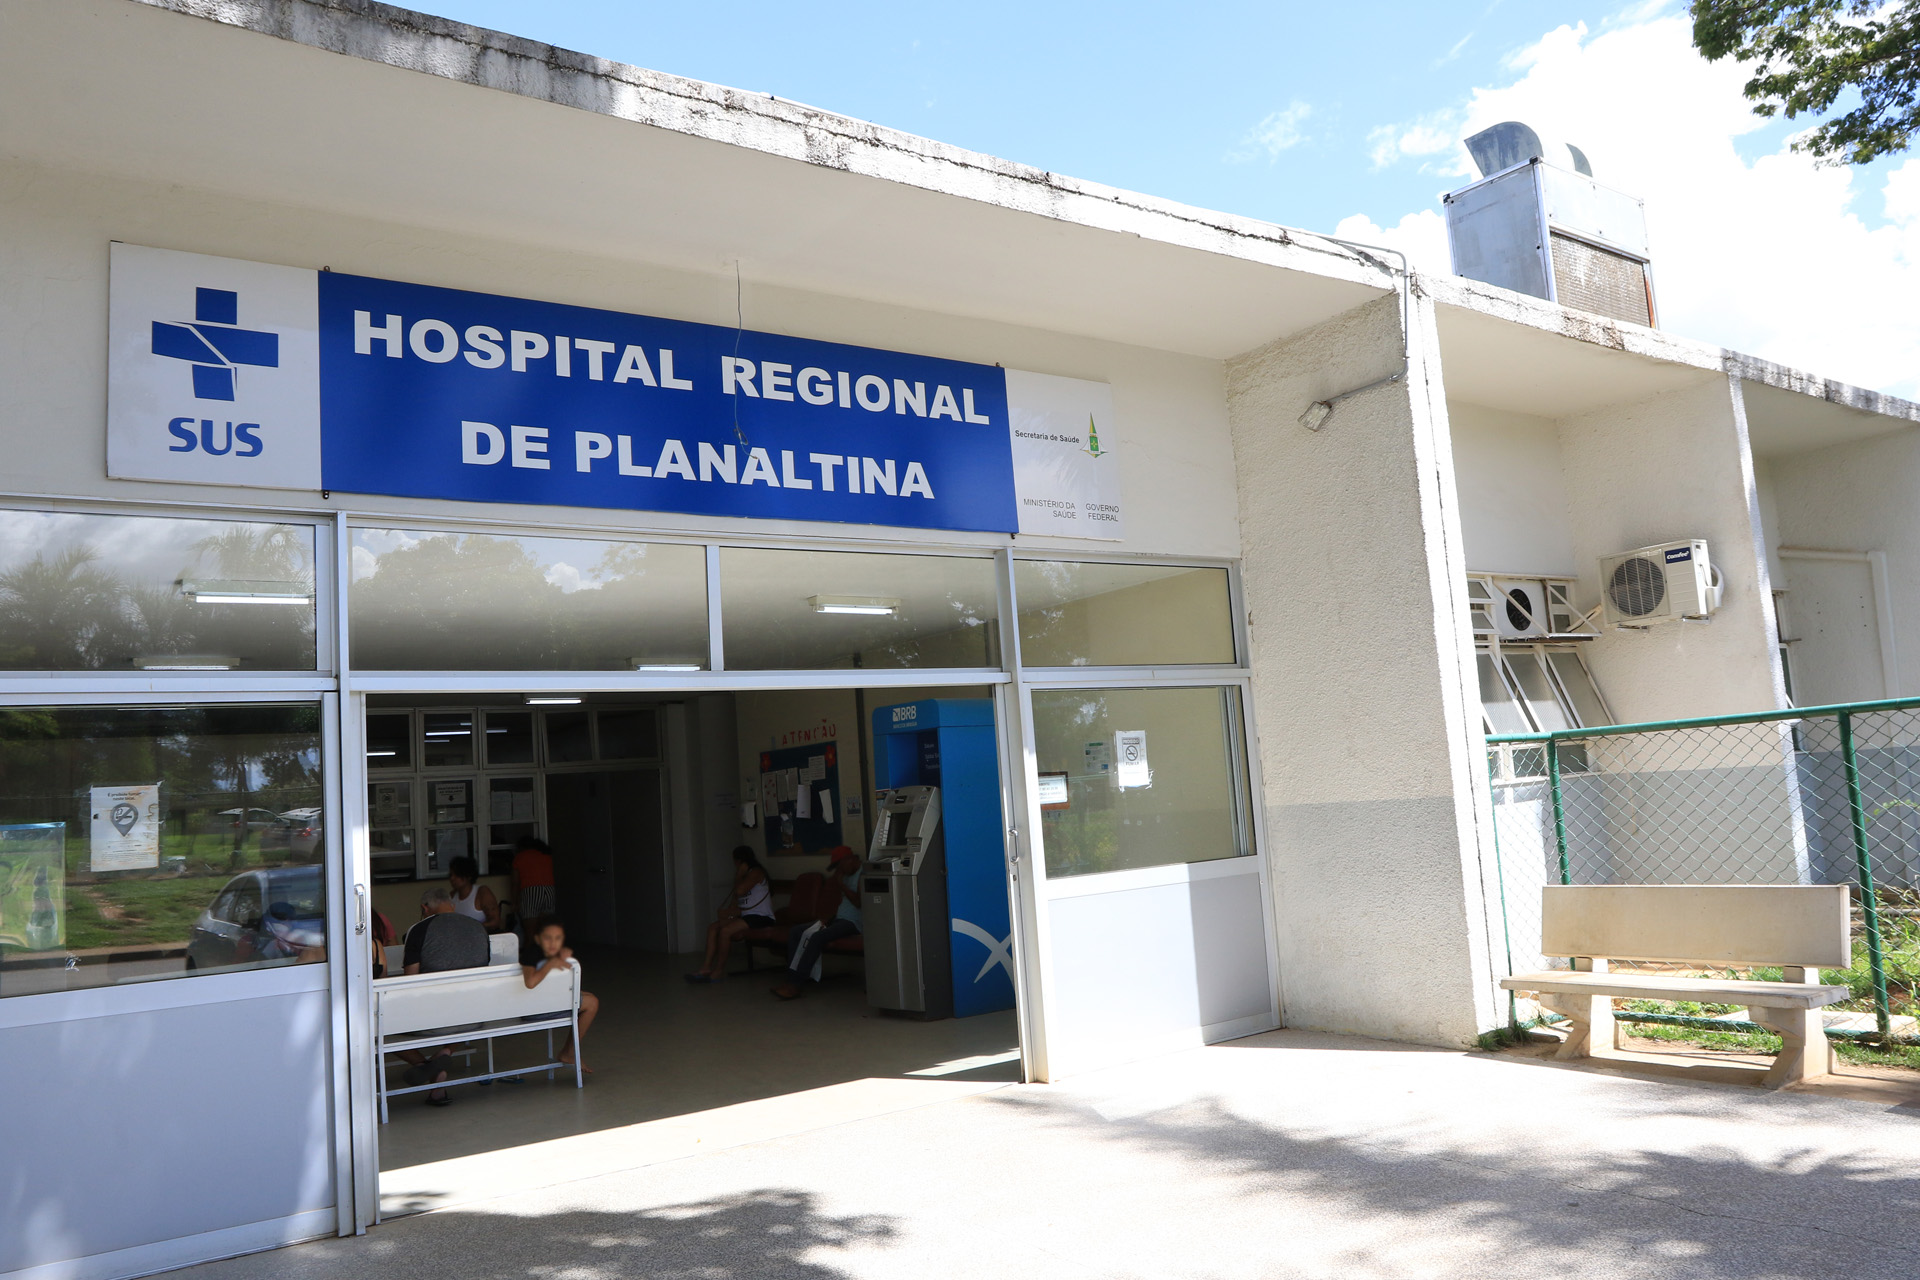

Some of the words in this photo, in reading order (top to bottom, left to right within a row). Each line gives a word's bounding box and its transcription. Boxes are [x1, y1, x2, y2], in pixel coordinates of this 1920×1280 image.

[354, 309, 693, 392] HOSPITAL
[721, 355, 990, 425] REGIONAL
[168, 416, 264, 458] SUS
[1015, 430, 1049, 441] Secretaria
[1050, 434, 1058, 442] de
[1060, 435, 1080, 444] Saúde
[462, 420, 551, 470] DE
[575, 430, 935, 500] PLANALTINA
[1023, 499, 1065, 509] MINISTÉRIO
[1066, 502, 1076, 510] DA
[1085, 503, 1120, 513] GOVERNO
[1053, 510, 1077, 519] SAÚDE
[1088, 513, 1119, 522] FEDERAL
[901, 705, 917, 721] BRB
